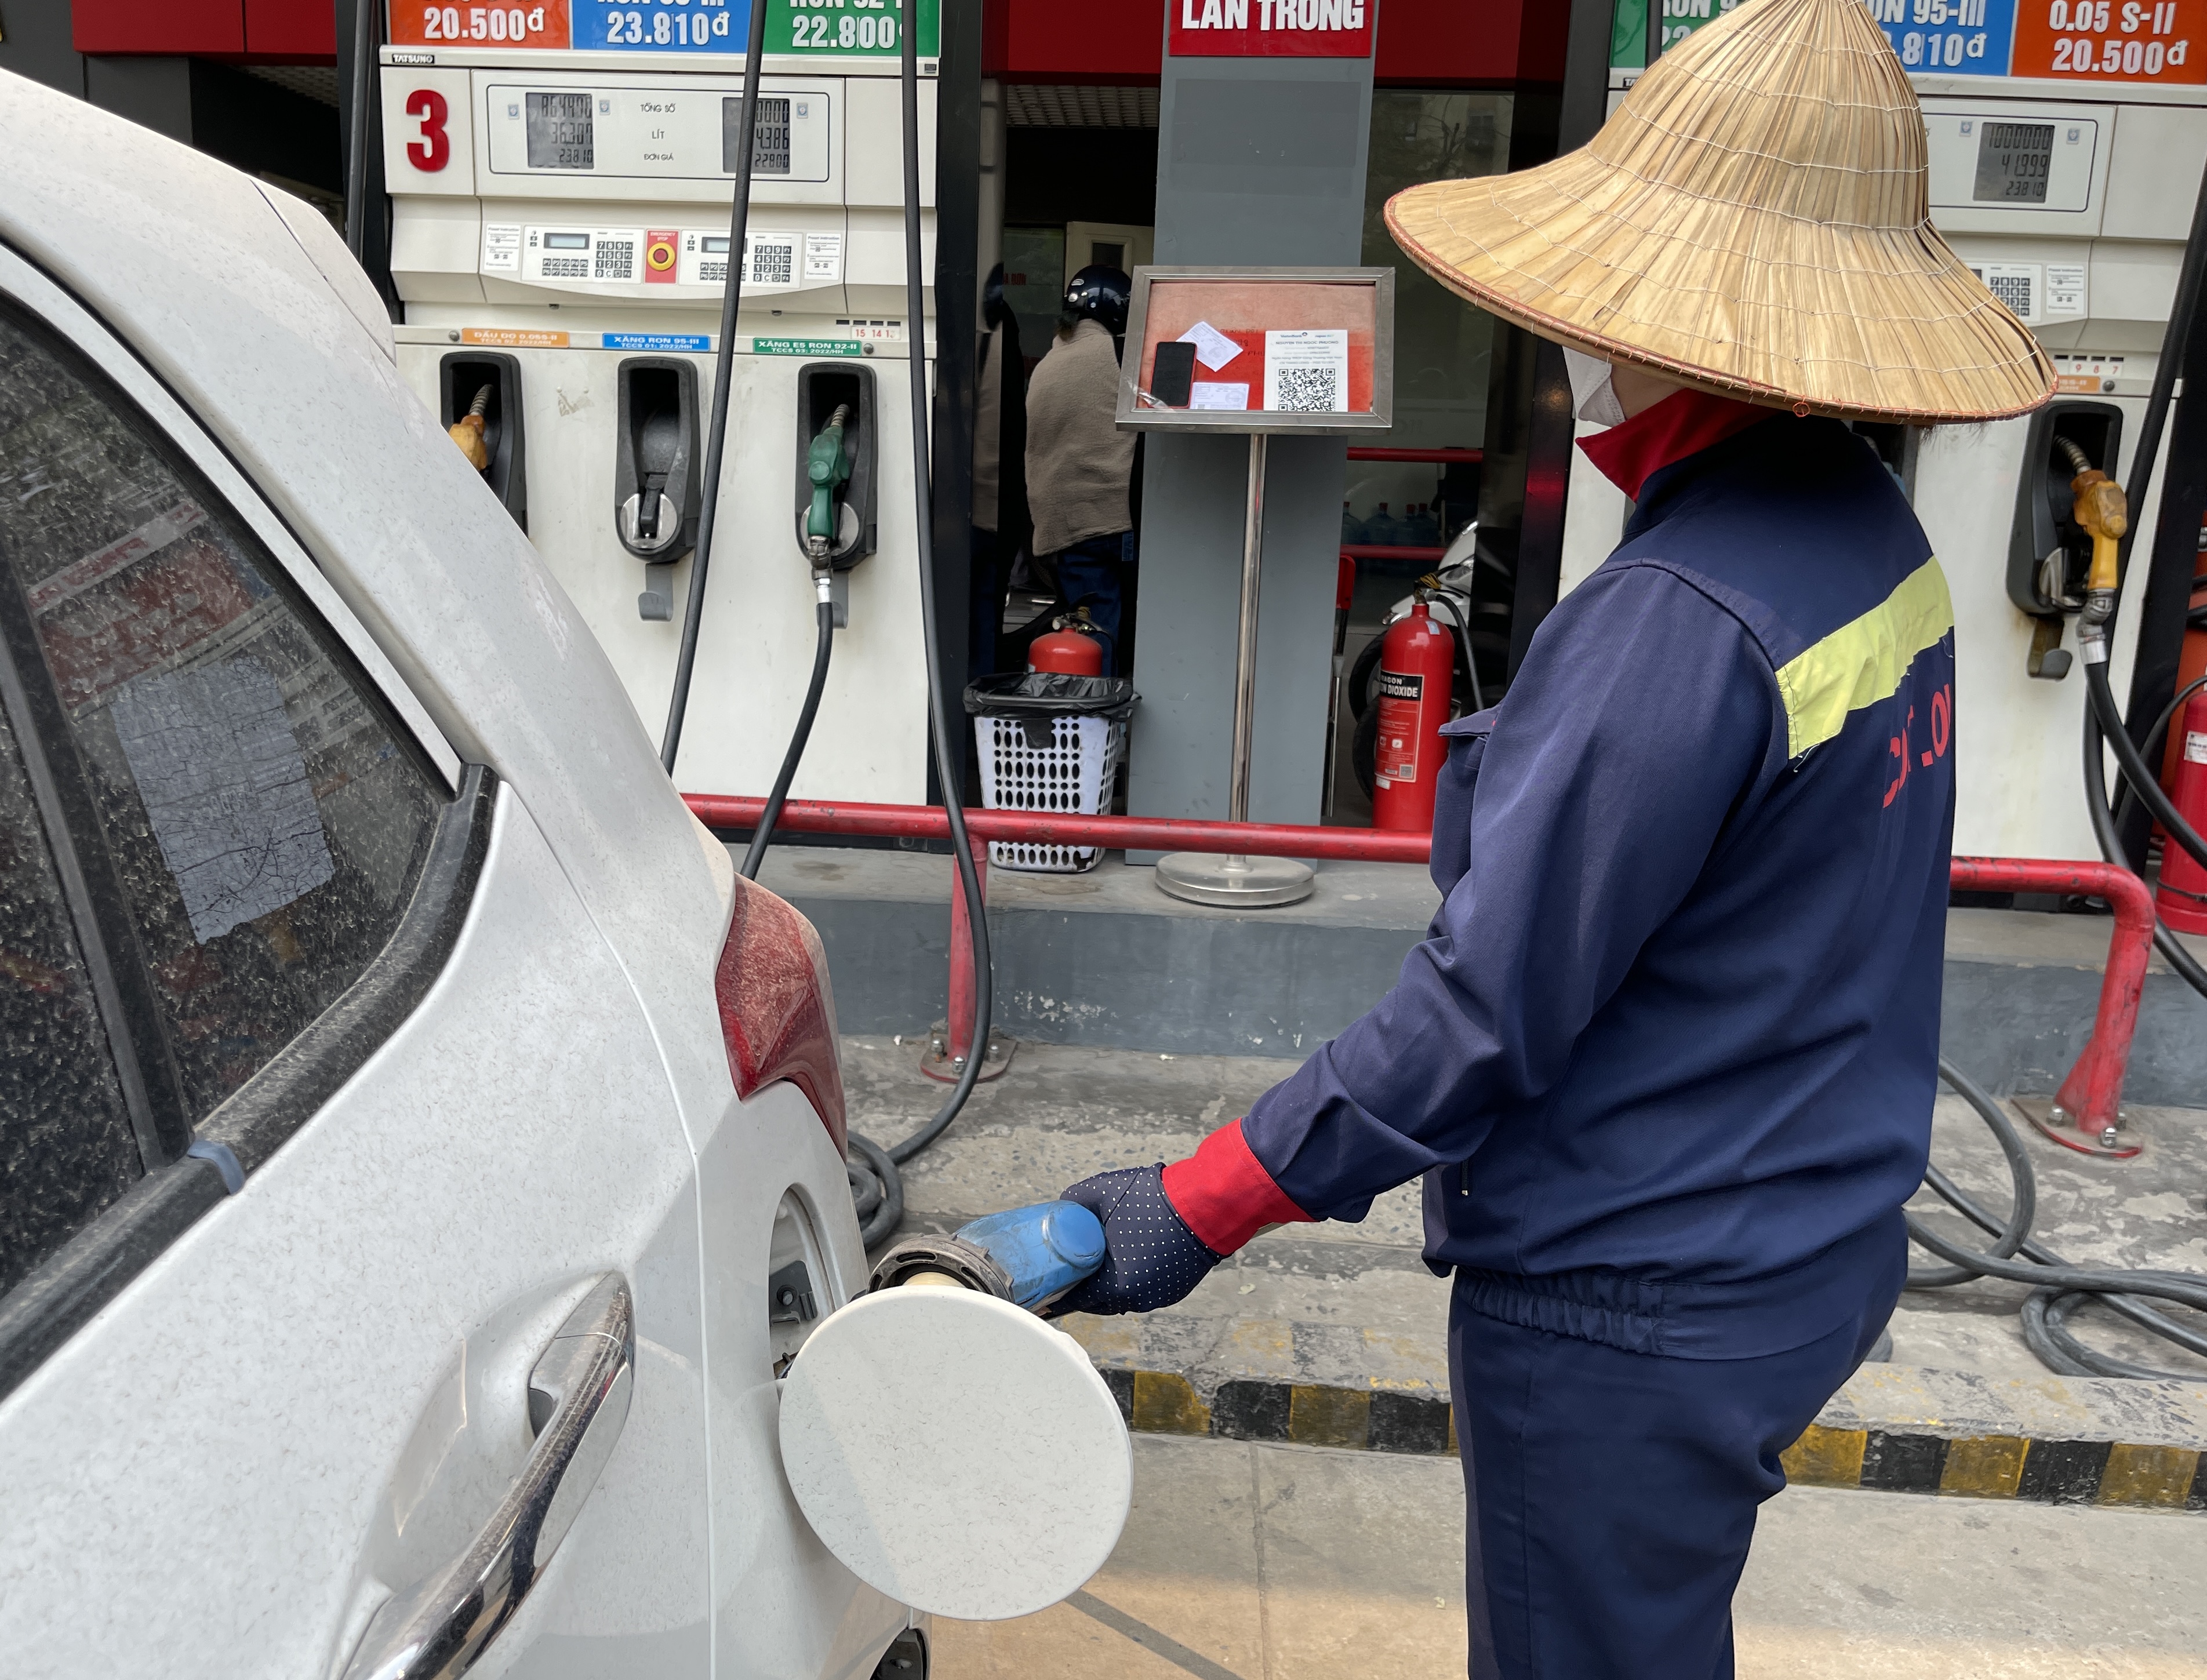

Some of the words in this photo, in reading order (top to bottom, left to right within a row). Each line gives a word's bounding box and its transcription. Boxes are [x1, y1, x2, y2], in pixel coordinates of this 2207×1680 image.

[2049, 0, 2110, 33] 0.05
[2120, 2, 2177, 35] S-II
[393, 54, 433, 64] TATSUNO
[640, 102, 662, 112] TỔNG
[664, 103, 676, 113] SỐ
[406, 89, 450, 172] 3
[652, 128, 665, 139] LÍT
[614, 335, 645, 343] XĂNG
[856, 329, 866, 337] 15
[872, 329, 882, 338] 14
[2075, 363, 2081, 373] 9
[2093, 365, 2099, 374] 8
[2112, 365, 2118, 374] 7
[1387, 685, 1419, 697] DIOXIDE
